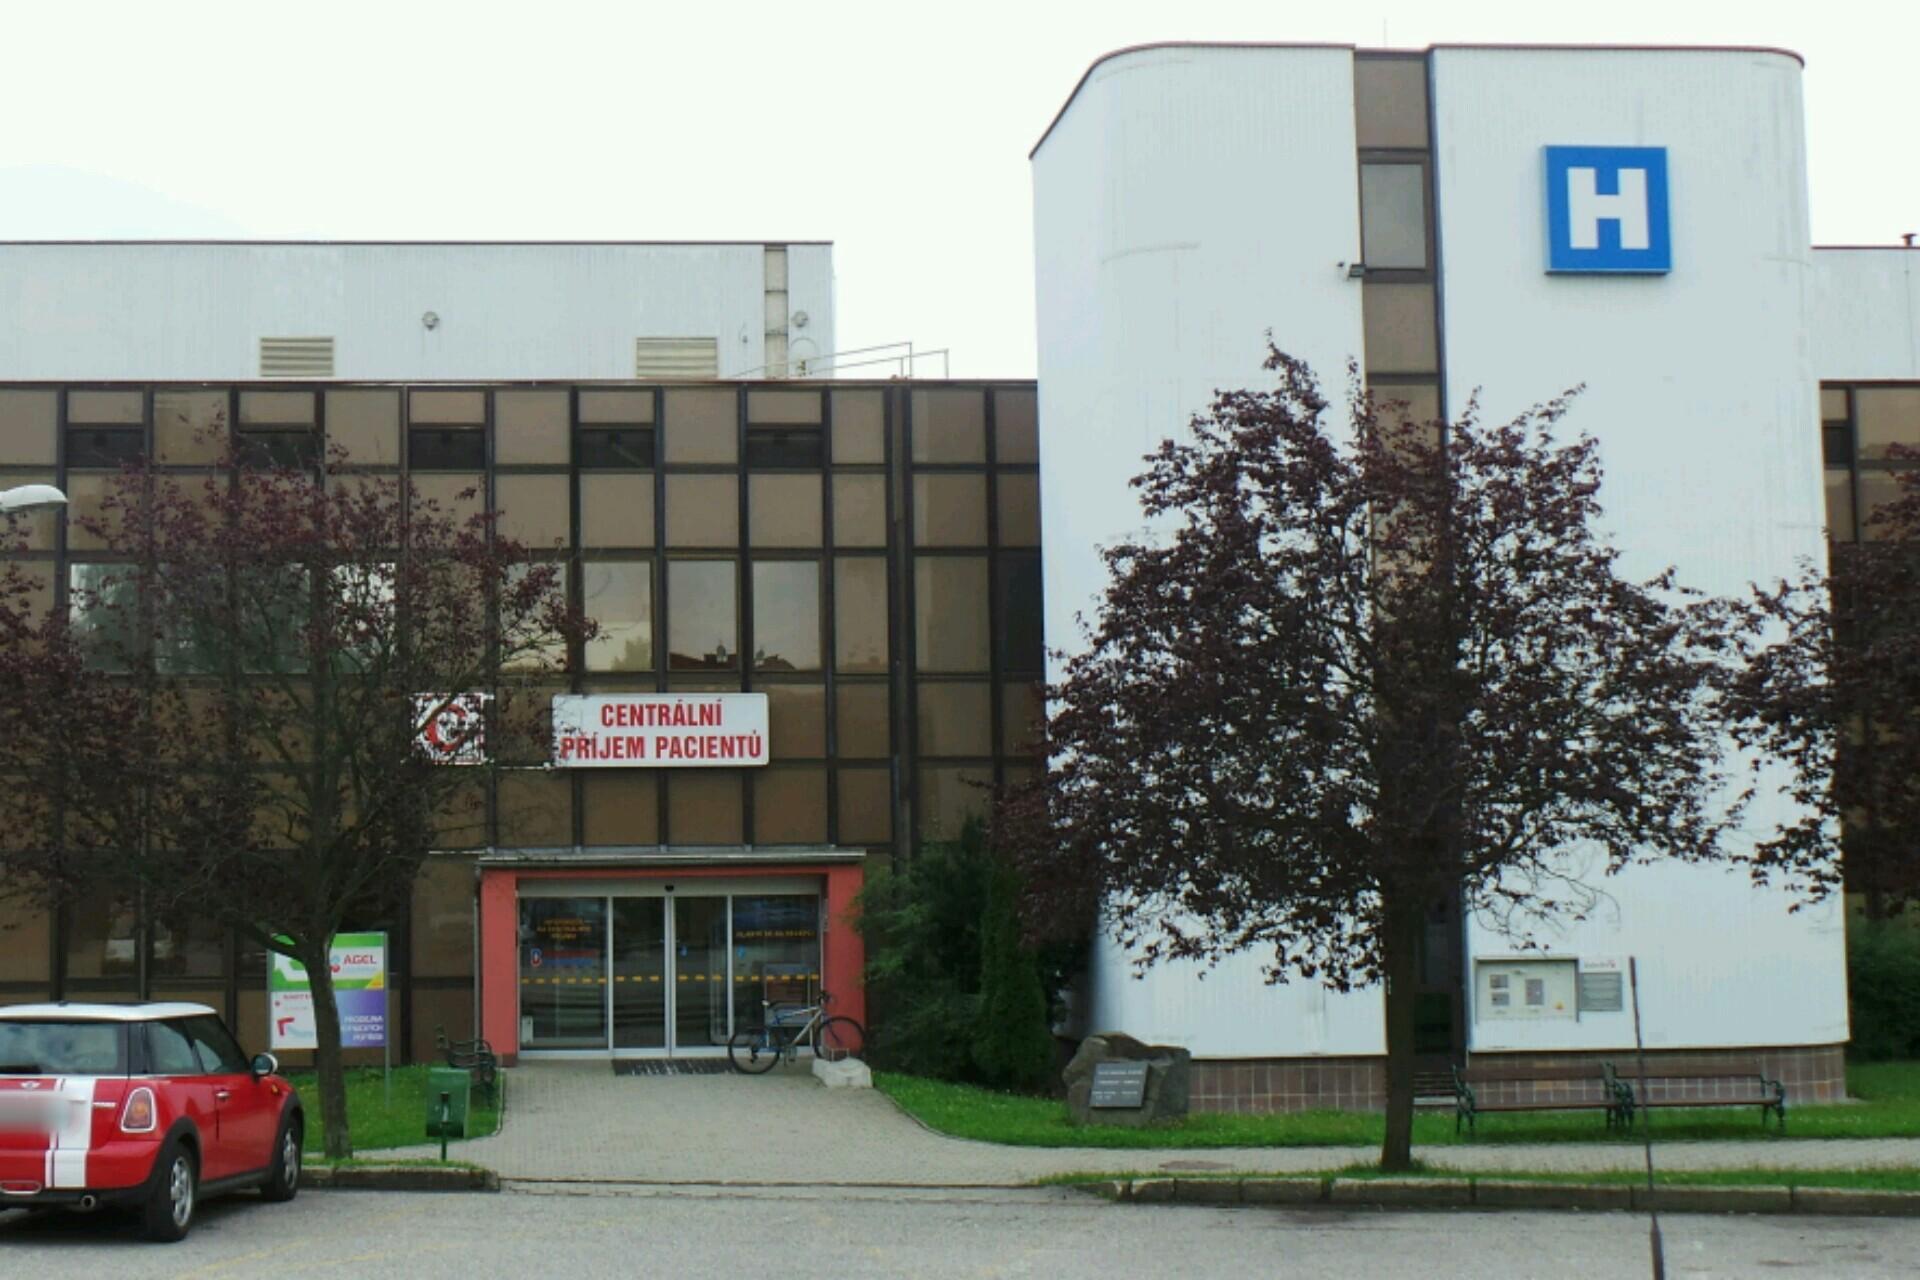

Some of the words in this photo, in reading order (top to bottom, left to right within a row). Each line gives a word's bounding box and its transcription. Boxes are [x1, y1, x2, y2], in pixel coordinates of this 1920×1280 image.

[1567, 167, 1649, 249] H
[601, 698, 722, 727] CENTRÁLNÍ
[655, 729, 761, 759] PACIENTŮ
